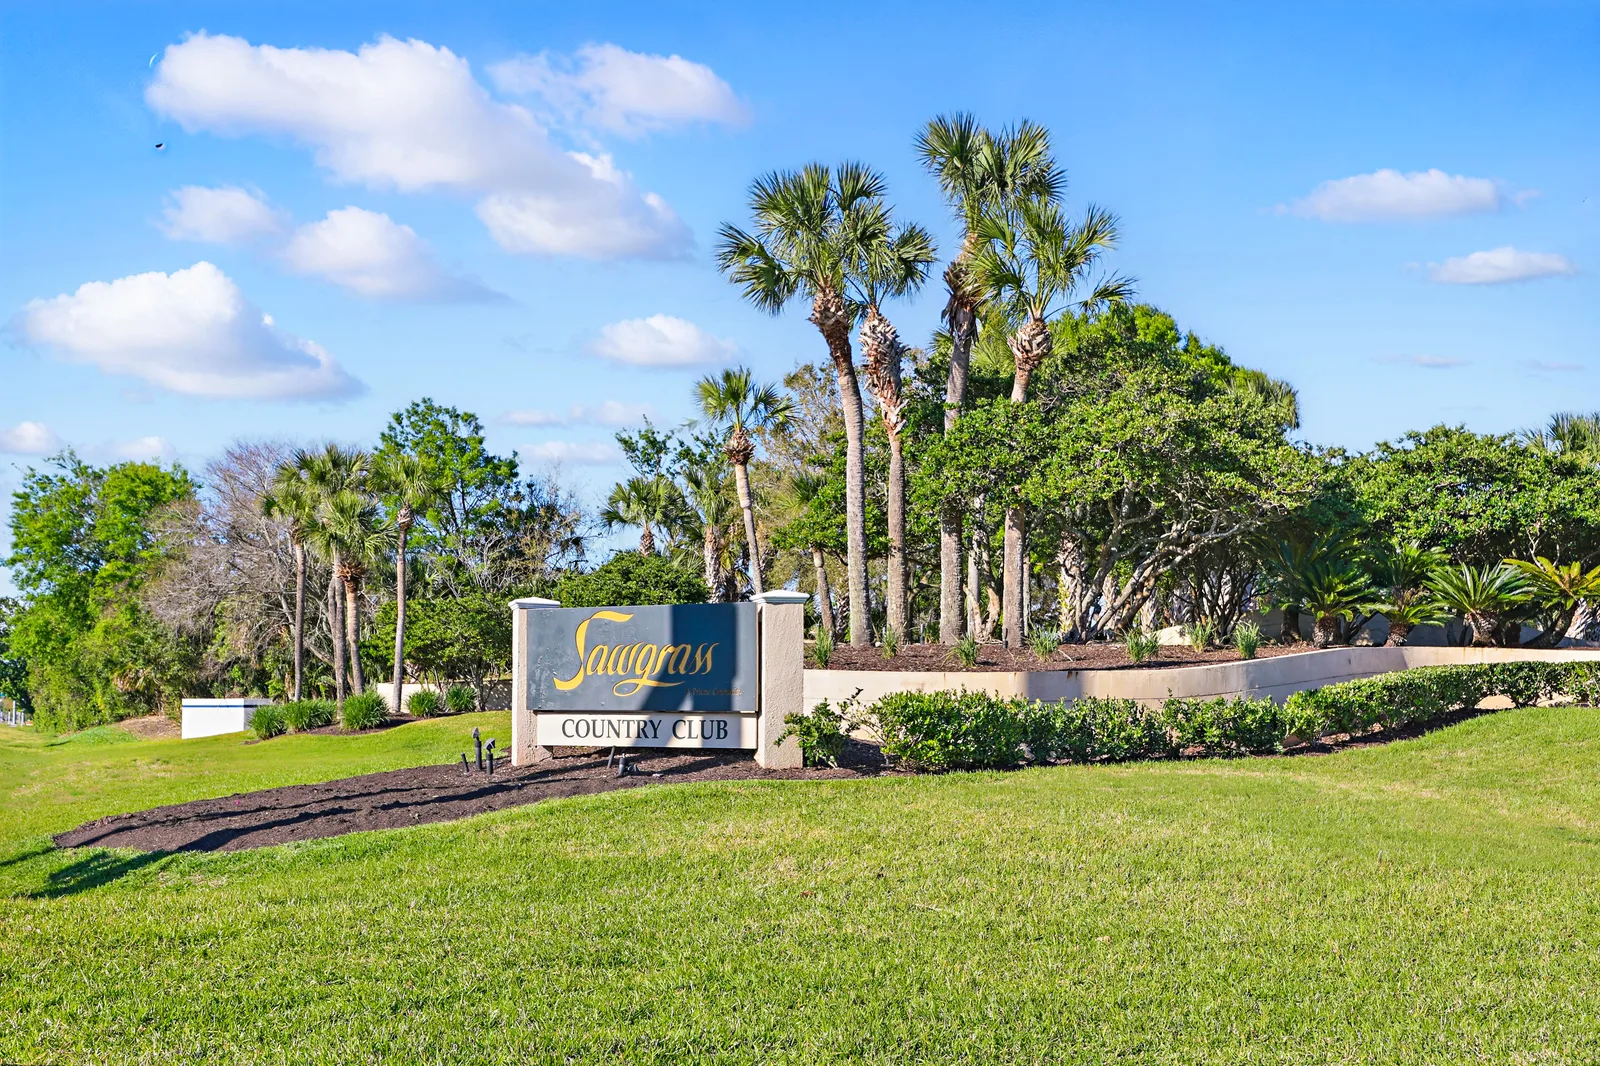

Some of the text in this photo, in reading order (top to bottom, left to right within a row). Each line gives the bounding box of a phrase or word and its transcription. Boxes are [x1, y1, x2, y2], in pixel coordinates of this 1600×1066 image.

[553, 610, 720, 697] Sawgrass
[562, 718, 728, 740] COUNTRY CLUB
